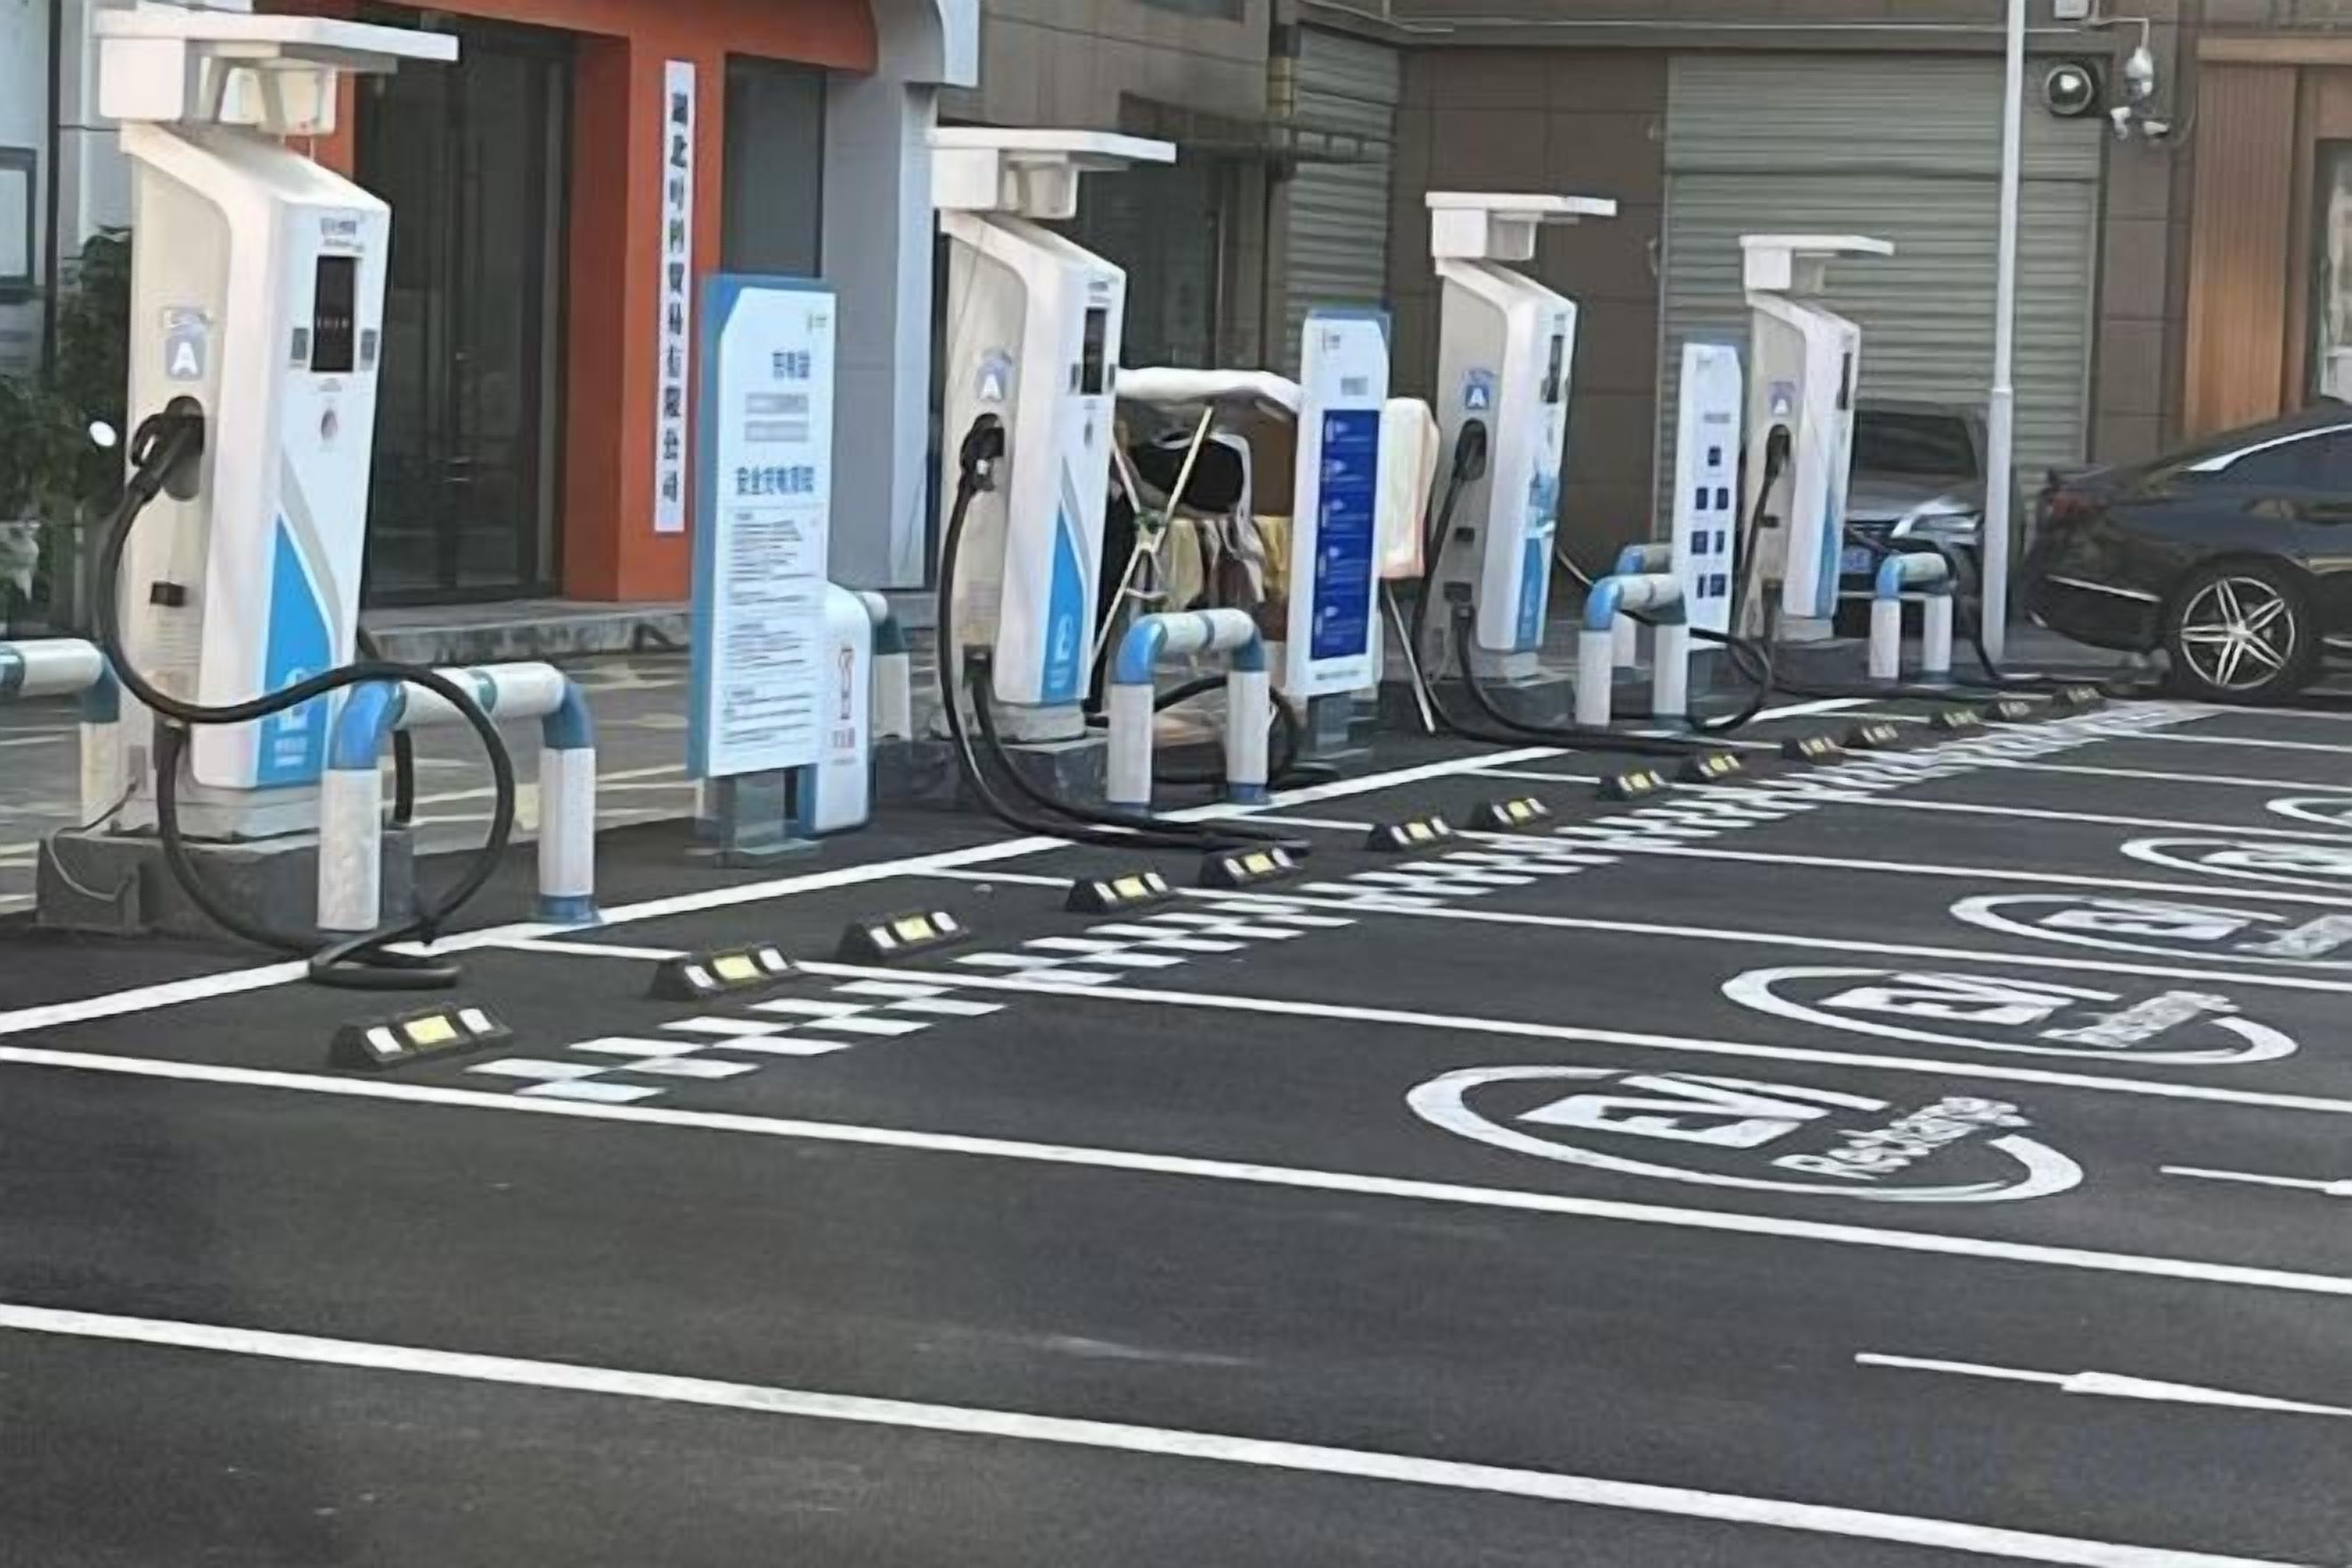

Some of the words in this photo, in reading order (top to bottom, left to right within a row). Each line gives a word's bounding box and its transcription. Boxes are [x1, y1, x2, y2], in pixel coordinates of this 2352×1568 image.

[171, 341, 199, 375] A
[1467, 387, 1486, 407] A
[1515, 1071, 1891, 1149] EV
